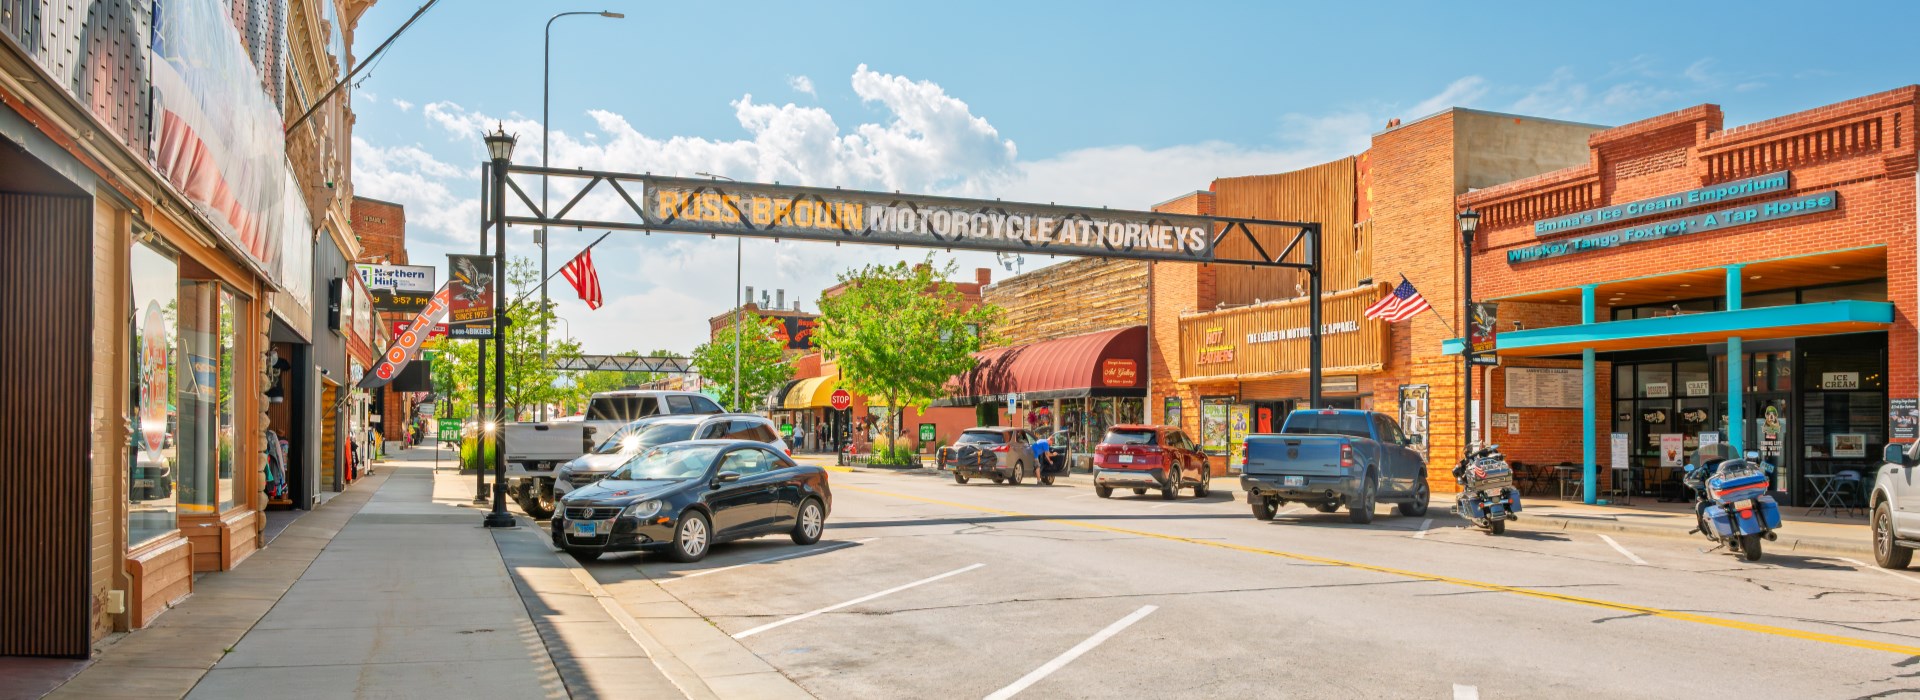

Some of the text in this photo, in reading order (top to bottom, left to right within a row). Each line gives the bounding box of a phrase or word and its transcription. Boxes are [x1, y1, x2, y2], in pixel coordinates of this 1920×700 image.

[1535, 176, 1784, 233] Emma's Ice Cream Emporium
[659, 190, 1205, 251] RUSS BROWN MOTORCYCLE ATTORNEYS
[1509, 196, 1831, 261] Whiskey Tango Foxtrot A Tap House
[375, 268, 425, 279] Northern
[375, 277, 398, 286] Hills
[393, 296, 411, 304] 3:57
[455, 311, 487, 321] SINCE 1975
[376, 288, 449, 379] ATTOOS
[1206, 328, 1222, 345] HOT
[1248, 333, 1257, 343] THE
[1258, 331, 1278, 342] LEADER
[1279, 330, 1286, 340] IN
[1328, 321, 1359, 334] APPAREL.
[1197, 346, 1233, 364] LEATHERS
[1117, 368, 1136, 378] Gallery
[832, 395, 850, 404] STOP
[441, 430, 458, 440] OPEN
